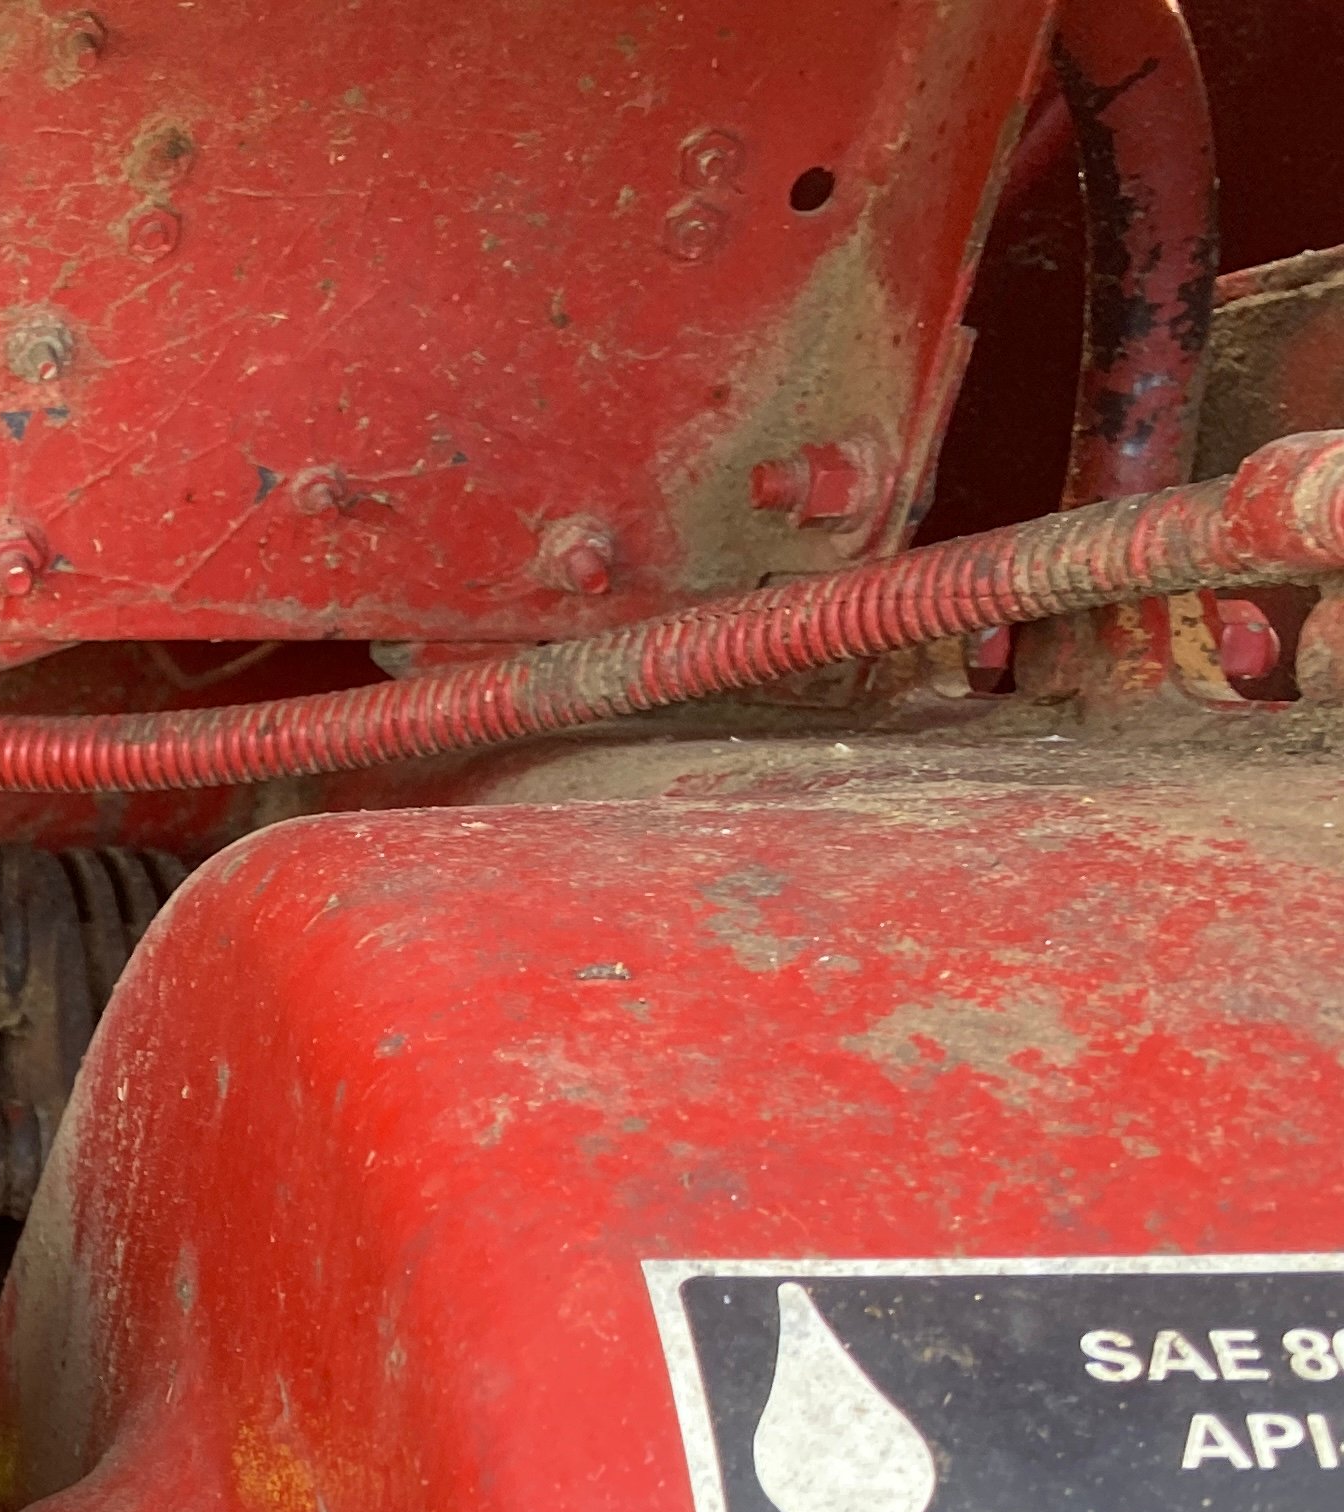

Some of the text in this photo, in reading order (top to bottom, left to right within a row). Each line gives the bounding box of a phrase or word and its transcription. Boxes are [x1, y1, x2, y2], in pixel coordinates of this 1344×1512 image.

[1079, 1327, 1344, 1382] SAE 8
[1181, 1412, 1344, 1469] API
